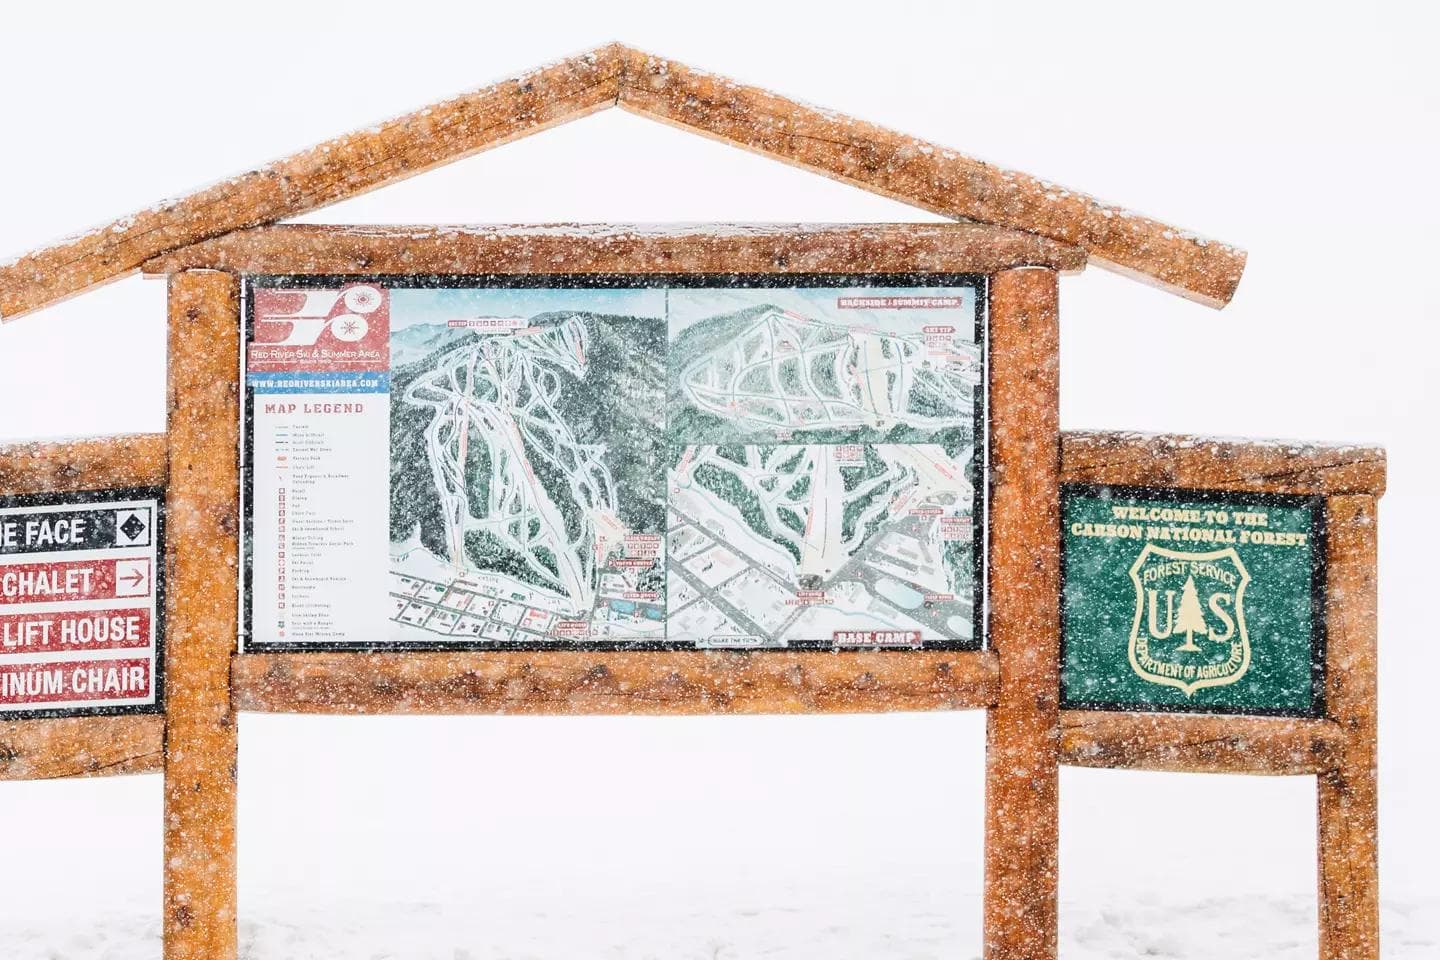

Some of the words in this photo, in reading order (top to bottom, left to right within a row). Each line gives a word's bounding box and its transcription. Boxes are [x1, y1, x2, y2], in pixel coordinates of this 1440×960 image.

[251, 349, 268, 359] RED
[270, 350, 295, 359] RIVER
[311, 350, 320, 359] &
[321, 349, 356, 359] SUMMER
[358, 350, 380, 359] AREA
[265, 403, 297, 414] MAP
[303, 403, 364, 414] LEGEND
[1112, 506, 1201, 524] WELCOME
[1207, 510, 1228, 525] TO
[1232, 511, 1268, 526] THE
[25, 518, 87, 546] FACE
[1146, 526, 1237, 543] NATIONAL
[1239, 530, 1308, 546] FOREST
[2, 568, 94, 597] CHALET
[1143, 561, 1188, 585] FOREST
[1190, 561, 1237, 588] SERVICE
[2, 620, 53, 647] LIFT
[61, 616, 141, 645] HOUSE
[837, 632, 872, 643] BASE
[875, 632, 916, 643] CAMP
[1136, 637, 1183, 677] DEPARTMENT
[1184, 665, 1195, 678] OF
[1197, 641, 1243, 678] AGRICULTURE
[72, 666, 146, 694] CHAIR
